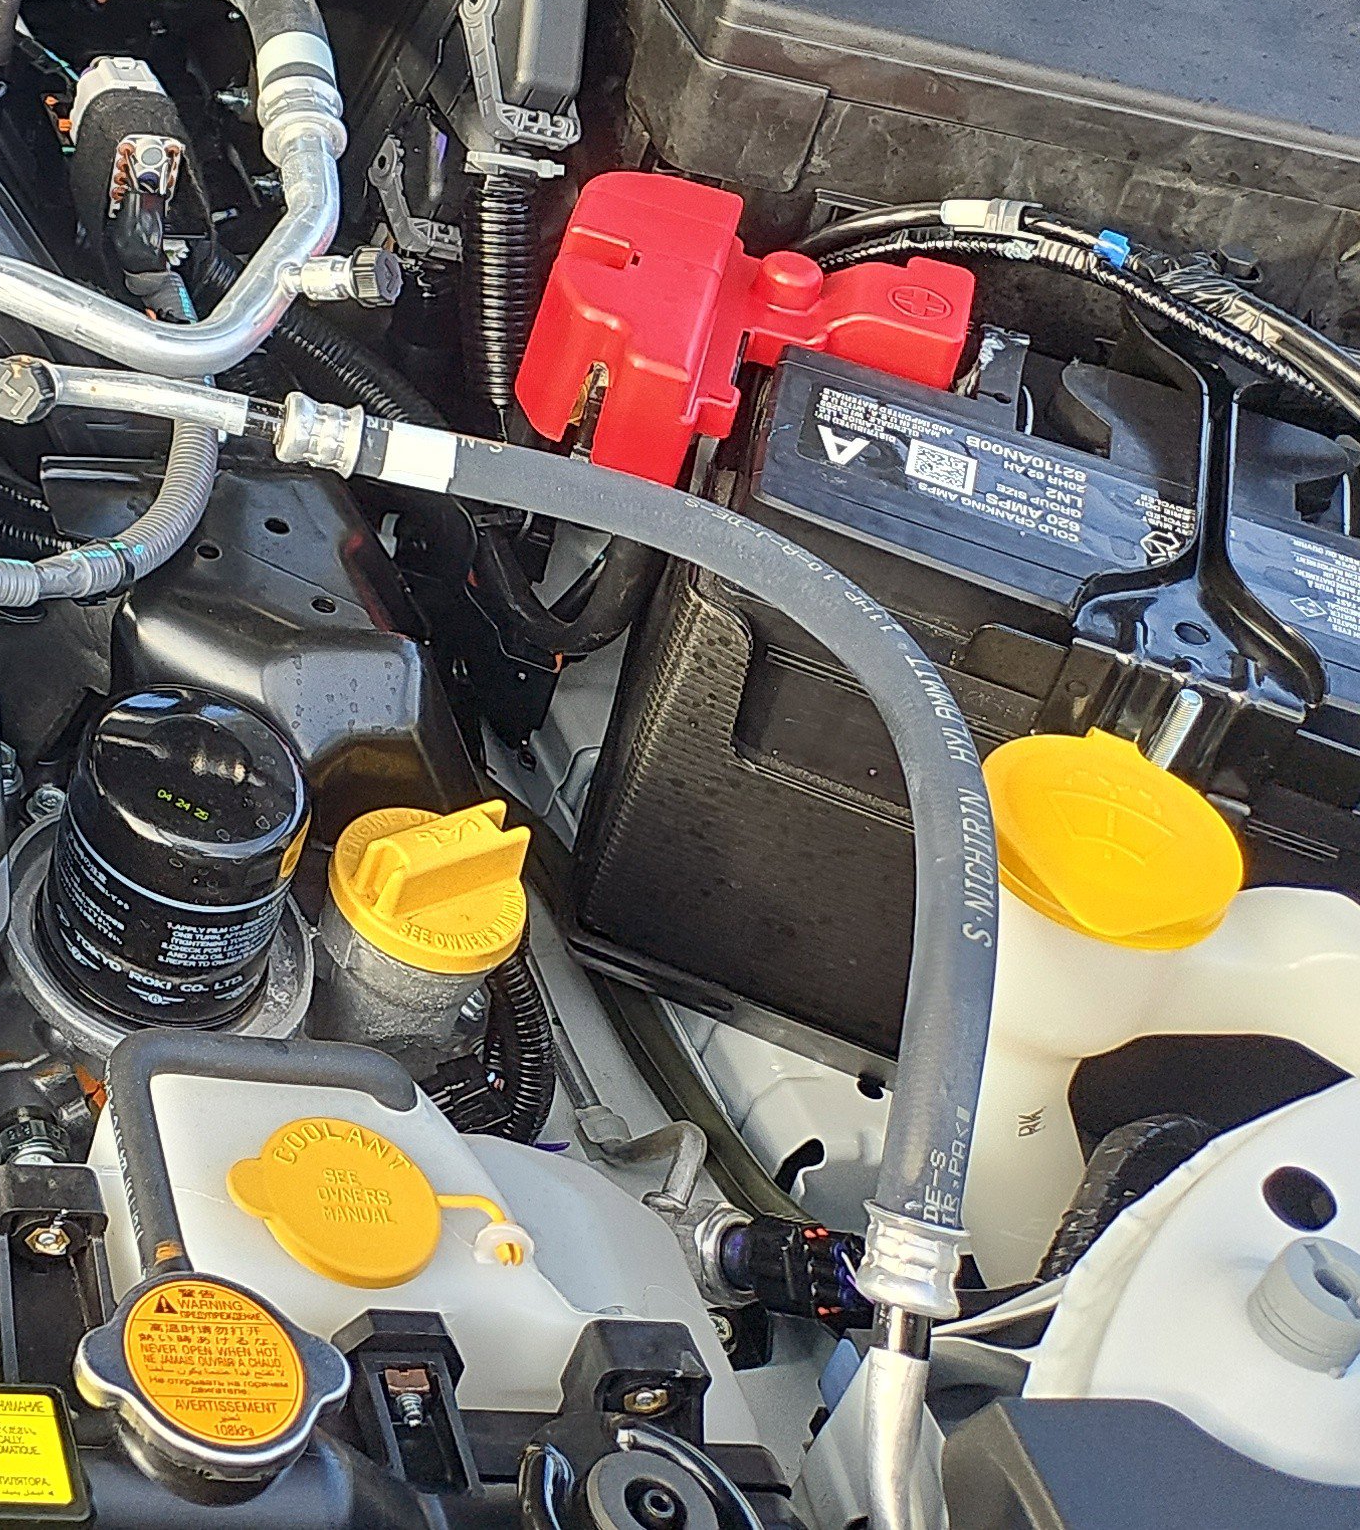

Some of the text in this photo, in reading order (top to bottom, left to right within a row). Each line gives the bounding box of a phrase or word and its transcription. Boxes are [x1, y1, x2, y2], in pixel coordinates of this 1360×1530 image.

[965, 435, 1087, 482] 82110AN00B
[1003, 461, 1027, 474] AH
[1047, 474, 1087, 493] 20HR
[996, 482, 1082, 518] GROUP SIZE
[1045, 486, 1083, 508] LN2
[918, 482, 1079, 542] COLD CRANKING AMPS
[985, 492, 1080, 532] 620 AMPS
[175, 798, 191, 811] 24
[399, 890, 524, 951] SEE OWNER'S MANUAL
[74, 930, 122, 972] TOKYO
[128, 971, 172, 990] ROKI
[273, 1121, 412, 1171] COOLANT
[323, 1168, 361, 1187] SEE
[317, 1186, 392, 1206] OWNERS
[324, 1206, 397, 1224] MANUAL
[178, 1299, 243, 1311] WARNING
[141, 1344, 177, 1353] NEVER
[182, 1345, 211, 1356] OPEN
[217, 1346, 251, 1357] WHEN
[143, 1355, 156, 1363] NE
[161, 1355, 194, 1365] JAMAIS
[198, 1356, 235, 1366] OUVRIR
[175, 1399, 277, 1413] AVERTISSEMENT
[214, 1425, 255, 1436] 108kPa
